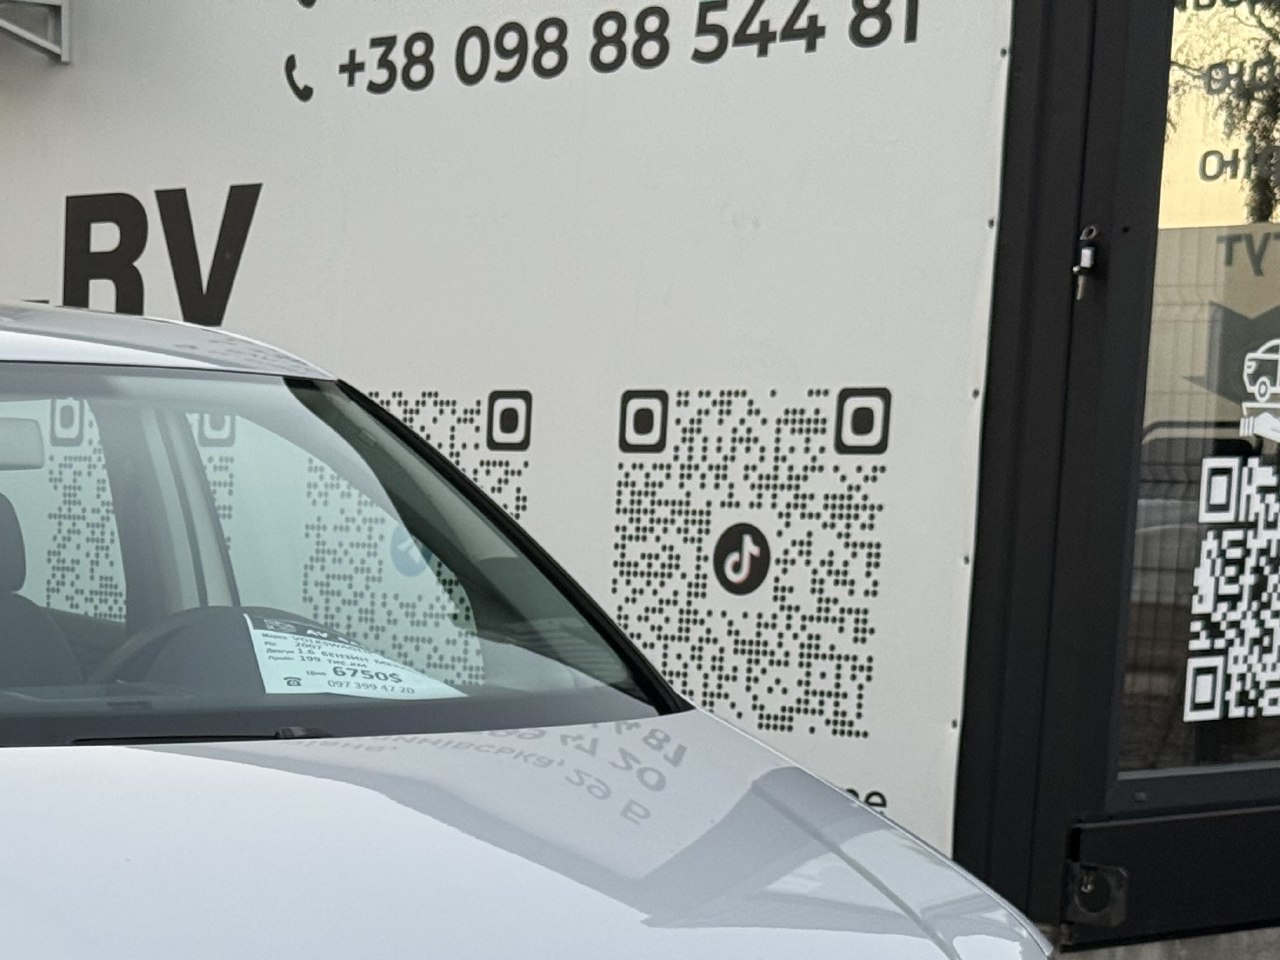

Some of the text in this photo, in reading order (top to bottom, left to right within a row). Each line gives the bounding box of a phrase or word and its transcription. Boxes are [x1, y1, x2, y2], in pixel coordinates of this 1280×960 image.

[338, 0, 919, 95] +38 098 88 544 81
[327, 679, 350, 688] 097
[332, 666, 403, 684] 6750$
